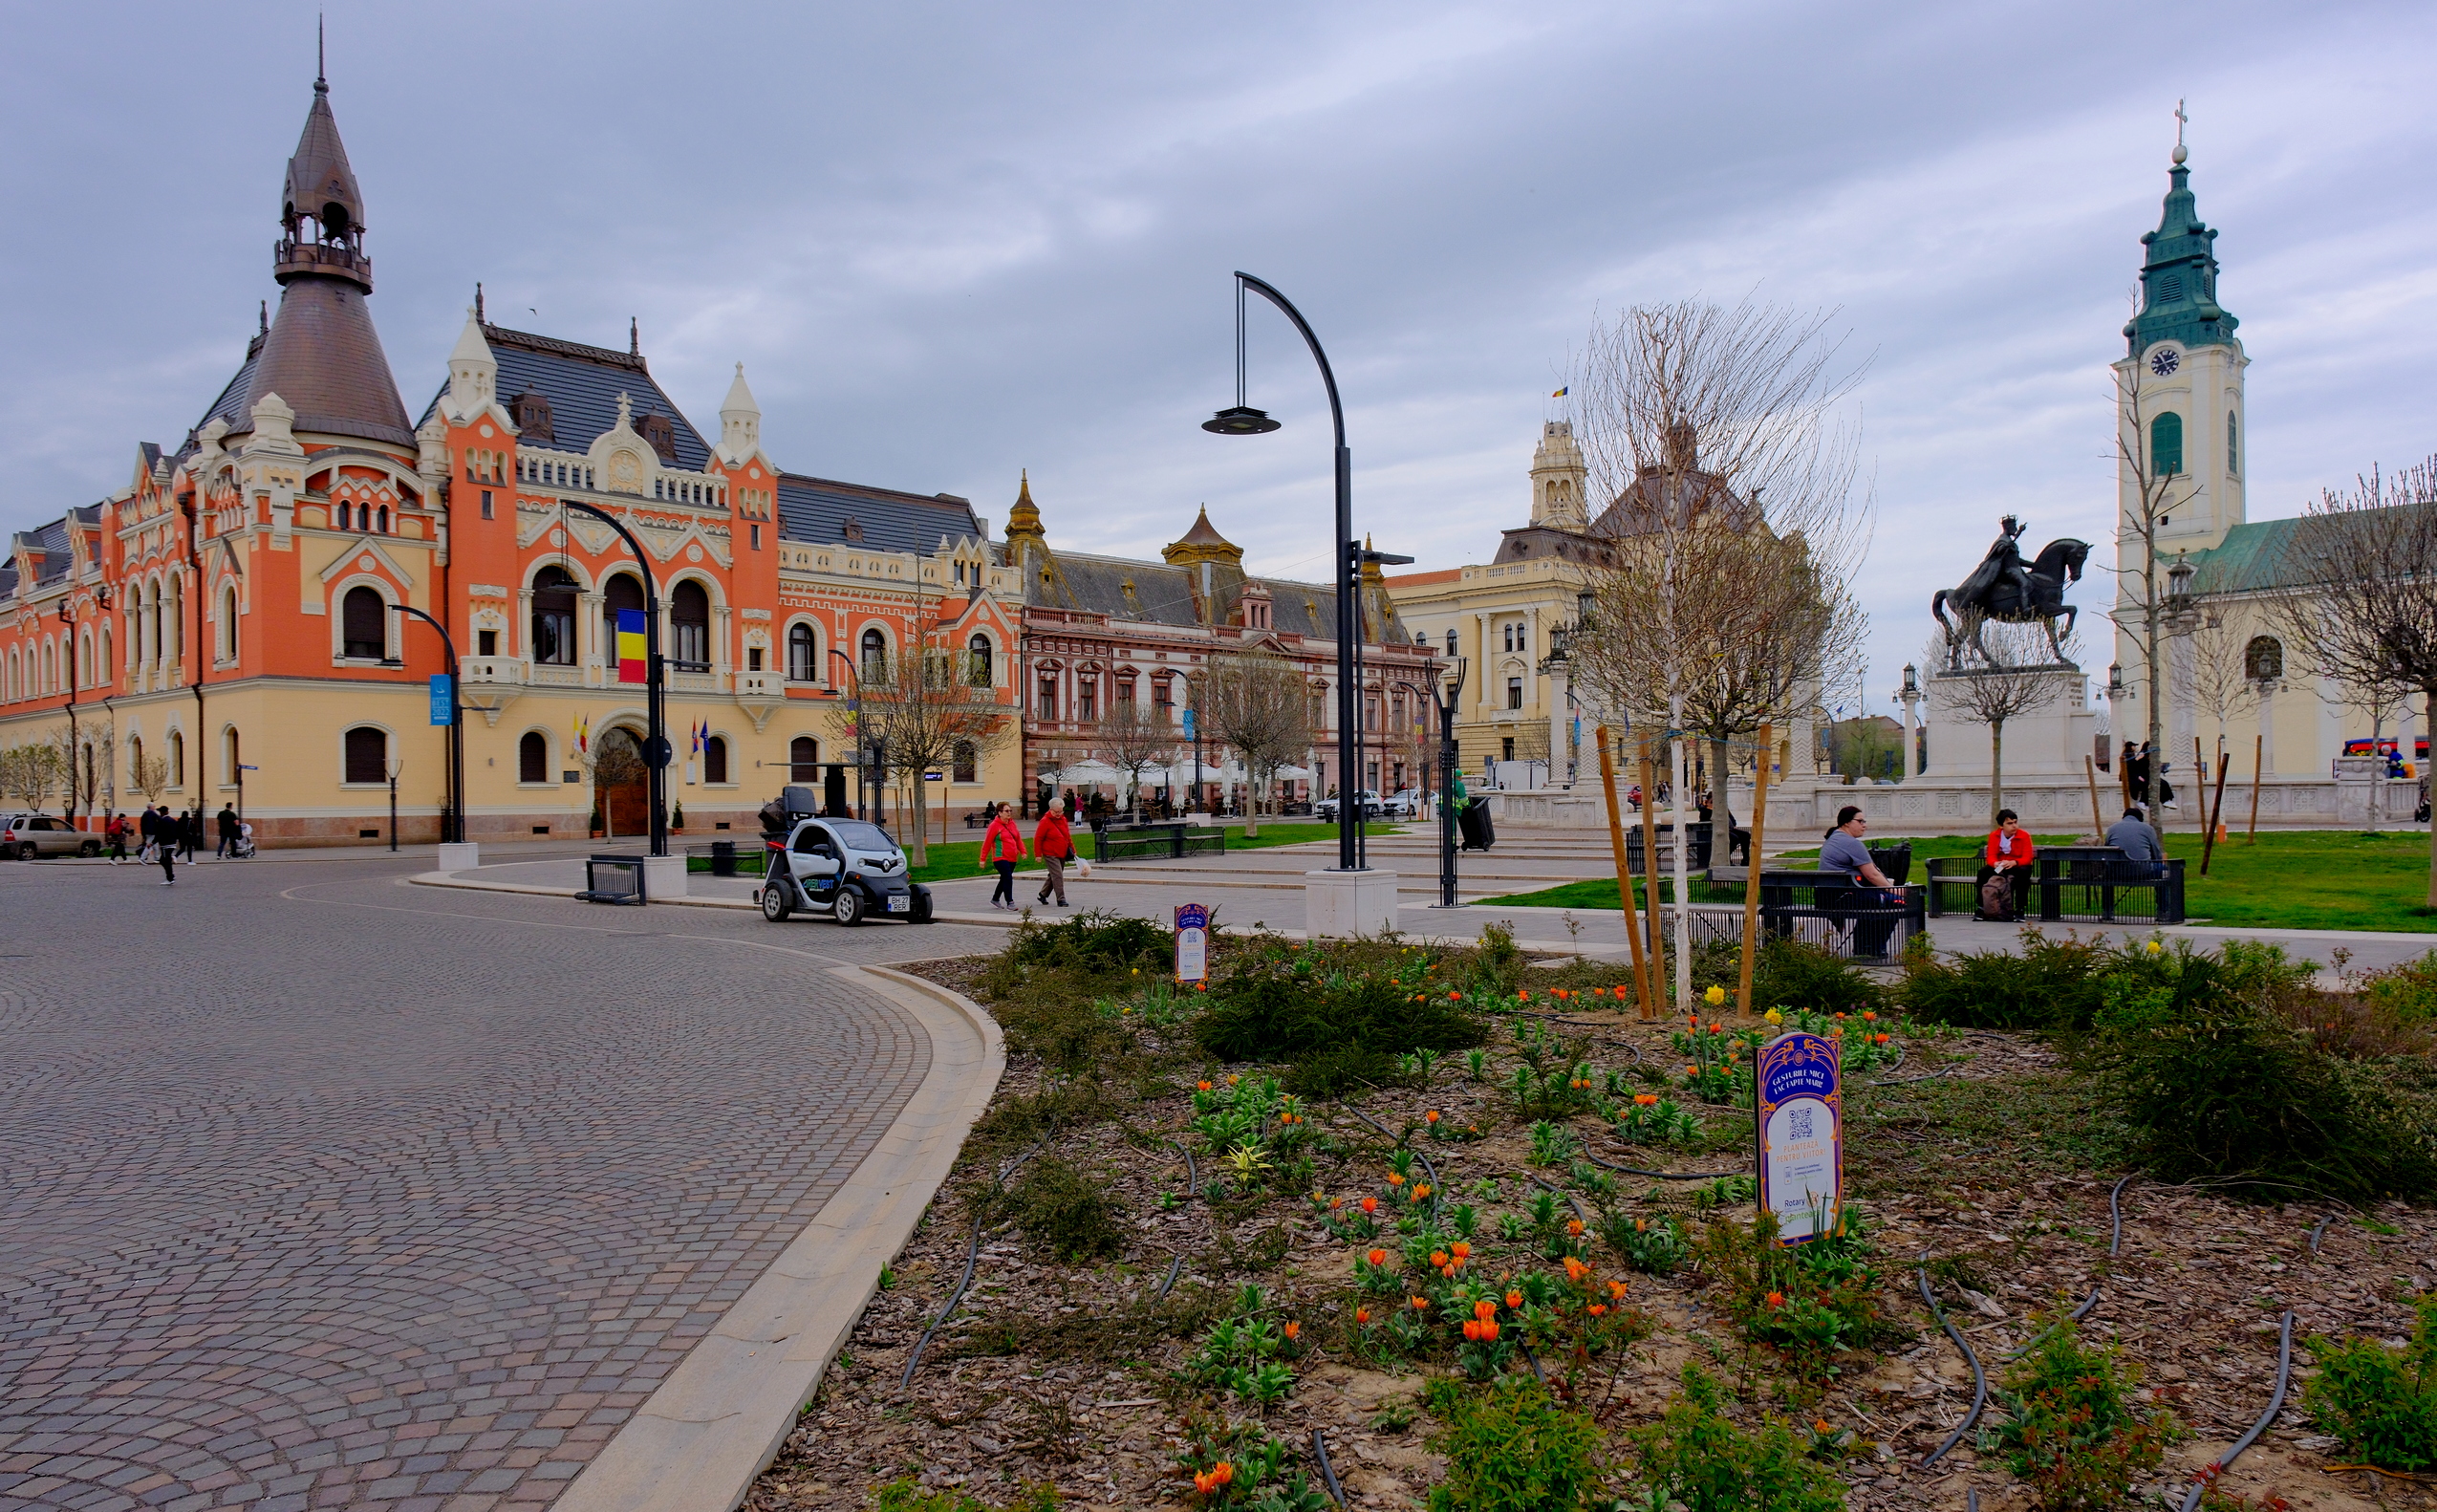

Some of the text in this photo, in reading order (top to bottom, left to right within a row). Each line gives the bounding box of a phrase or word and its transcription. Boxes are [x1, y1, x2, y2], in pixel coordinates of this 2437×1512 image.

[1772, 1069, 1824, 1086] GESTURILE MICI
[1774, 1084, 1785, 1094] FAC
[1786, 1078, 1804, 1088] FAPTE
[1777, 1149, 1826, 1163] PENTRU VIITOR!
[1784, 1199, 1805, 1207] Rotary
